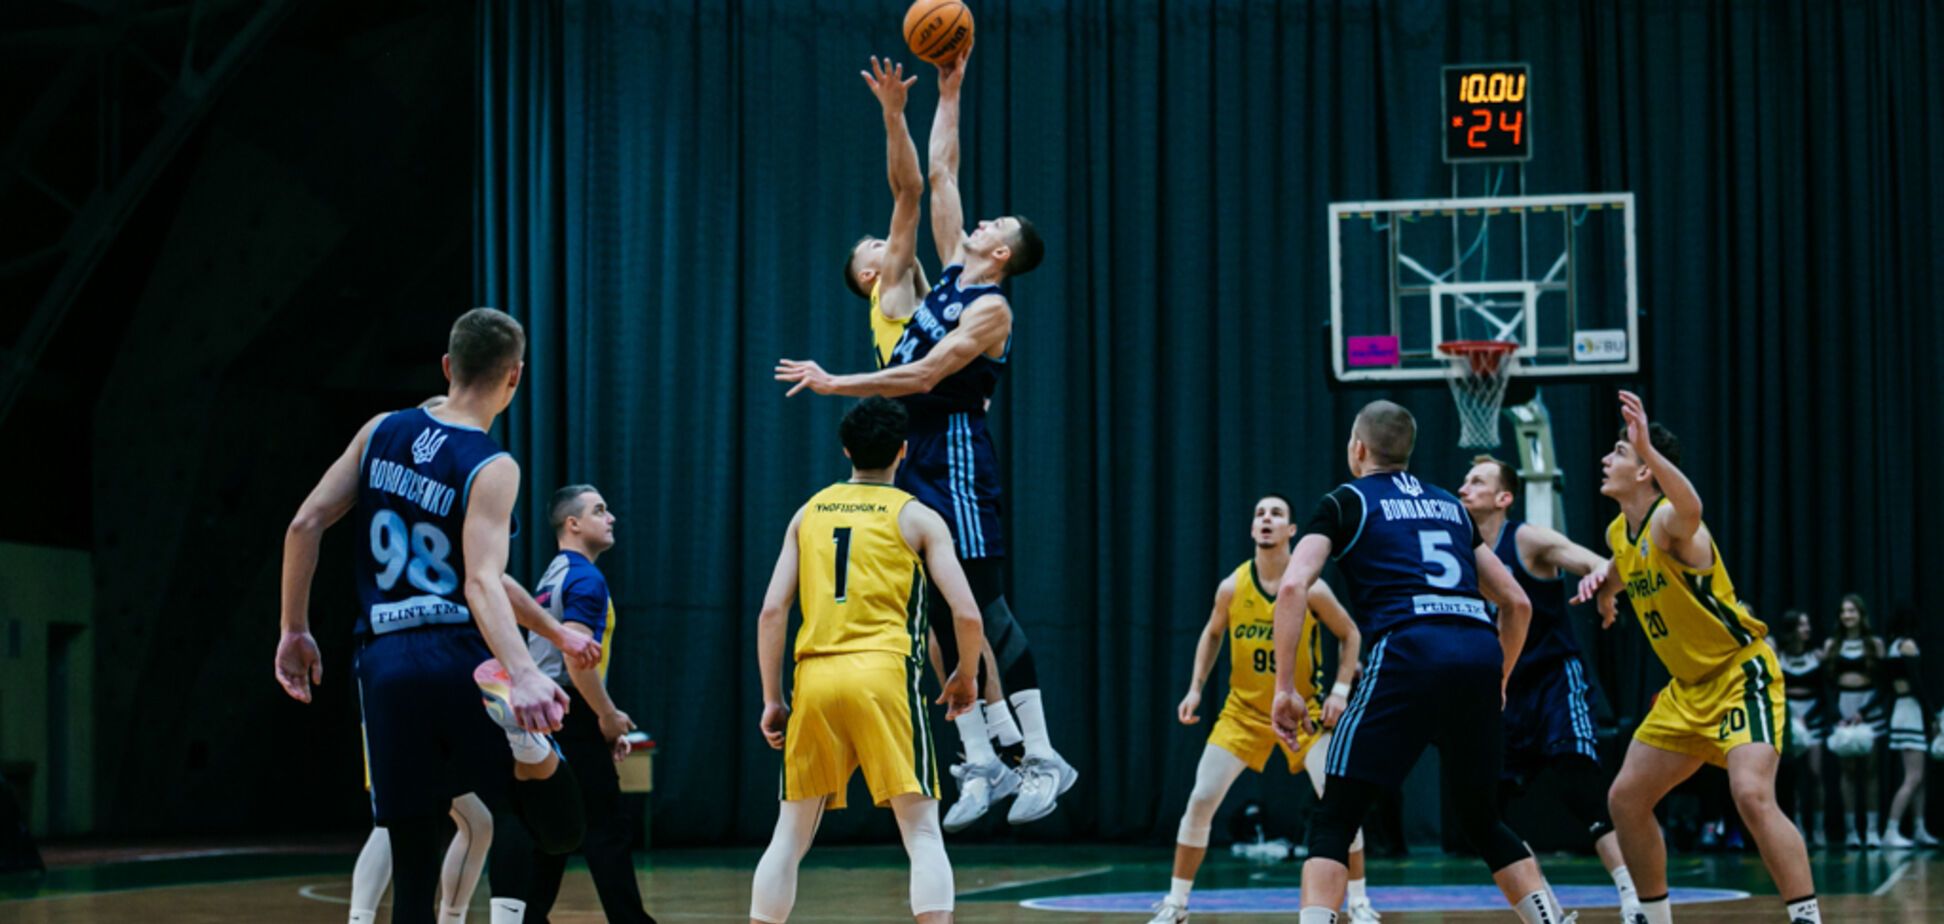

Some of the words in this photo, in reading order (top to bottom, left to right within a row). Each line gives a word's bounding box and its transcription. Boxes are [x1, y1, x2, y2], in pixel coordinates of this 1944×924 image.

[1467, 108, 1523, 148] 24
[370, 508, 459, 596] 98
[832, 526, 853, 605] 1
[1418, 529, 1462, 589] 5
[1718, 706, 1746, 741] 20
